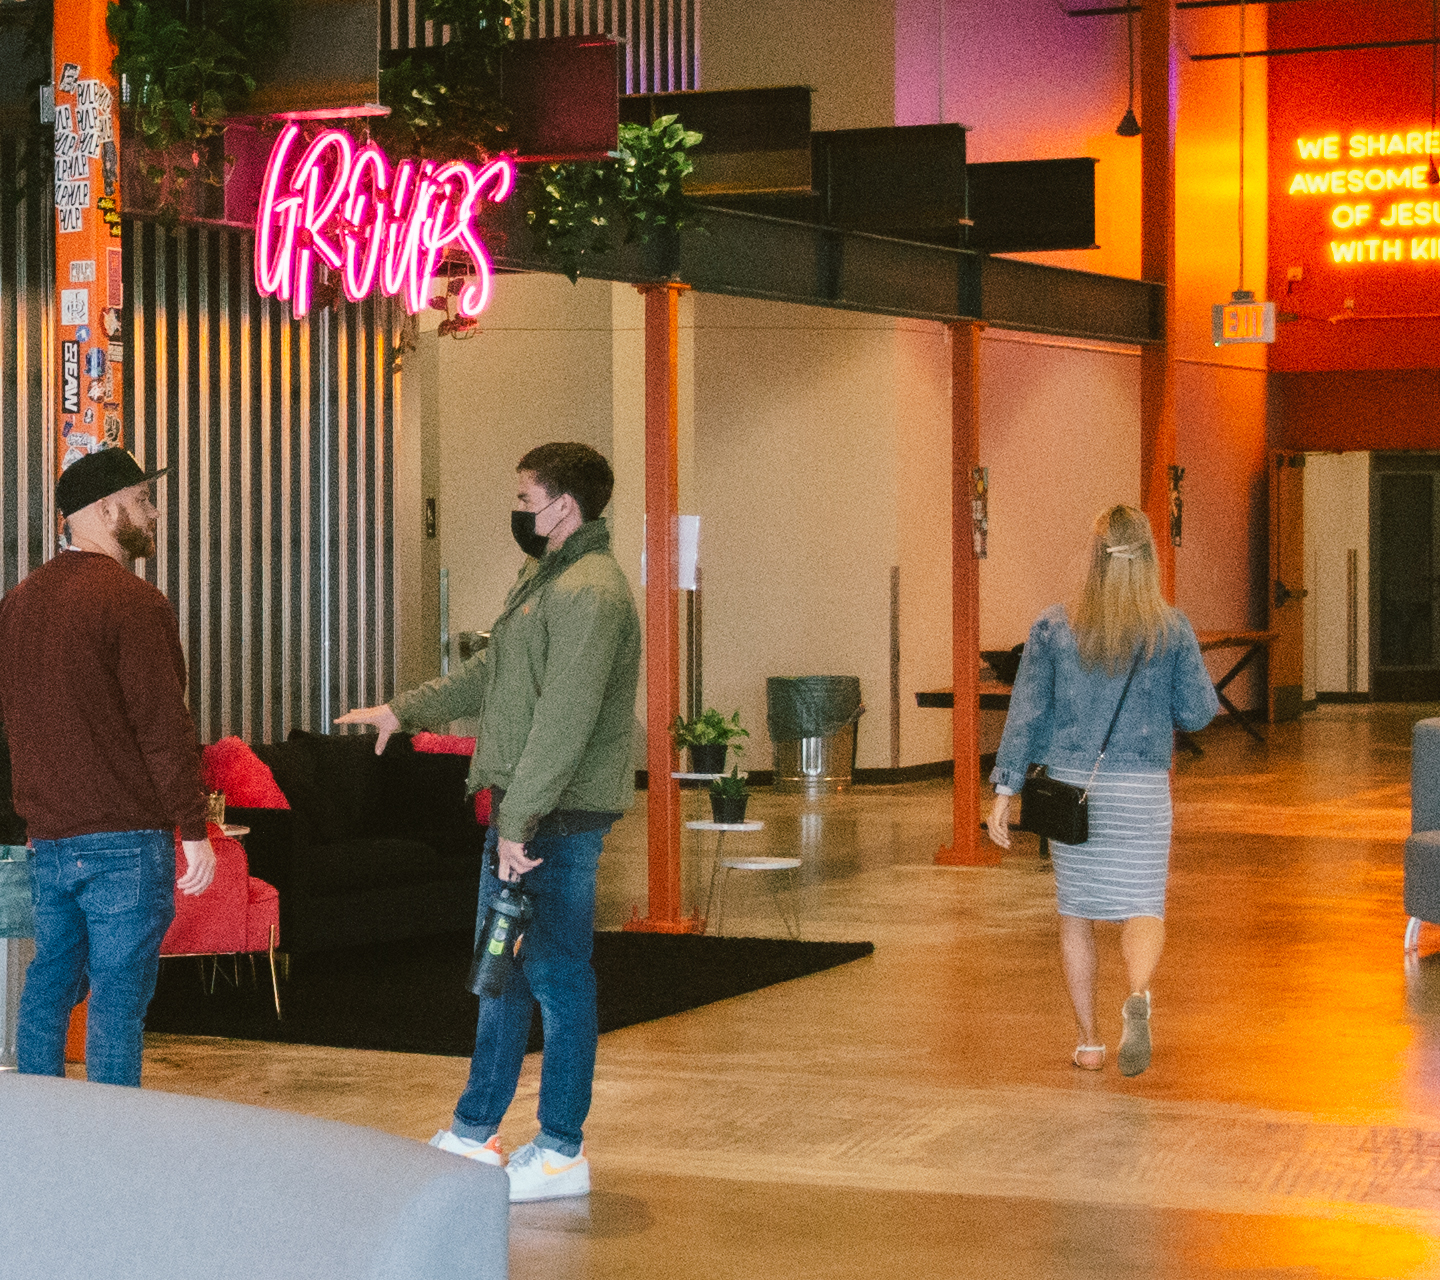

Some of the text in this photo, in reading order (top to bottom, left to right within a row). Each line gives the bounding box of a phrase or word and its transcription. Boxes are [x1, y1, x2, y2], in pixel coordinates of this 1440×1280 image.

[1297, 135, 1340, 161] WE
[1289, 164, 1429, 195] AWESOME
[256, 123, 515, 319] GROUPS
[1331, 203, 1371, 230] OF
[1330, 237, 1404, 263] WITH
[1223, 305, 1264, 338] EXIT
